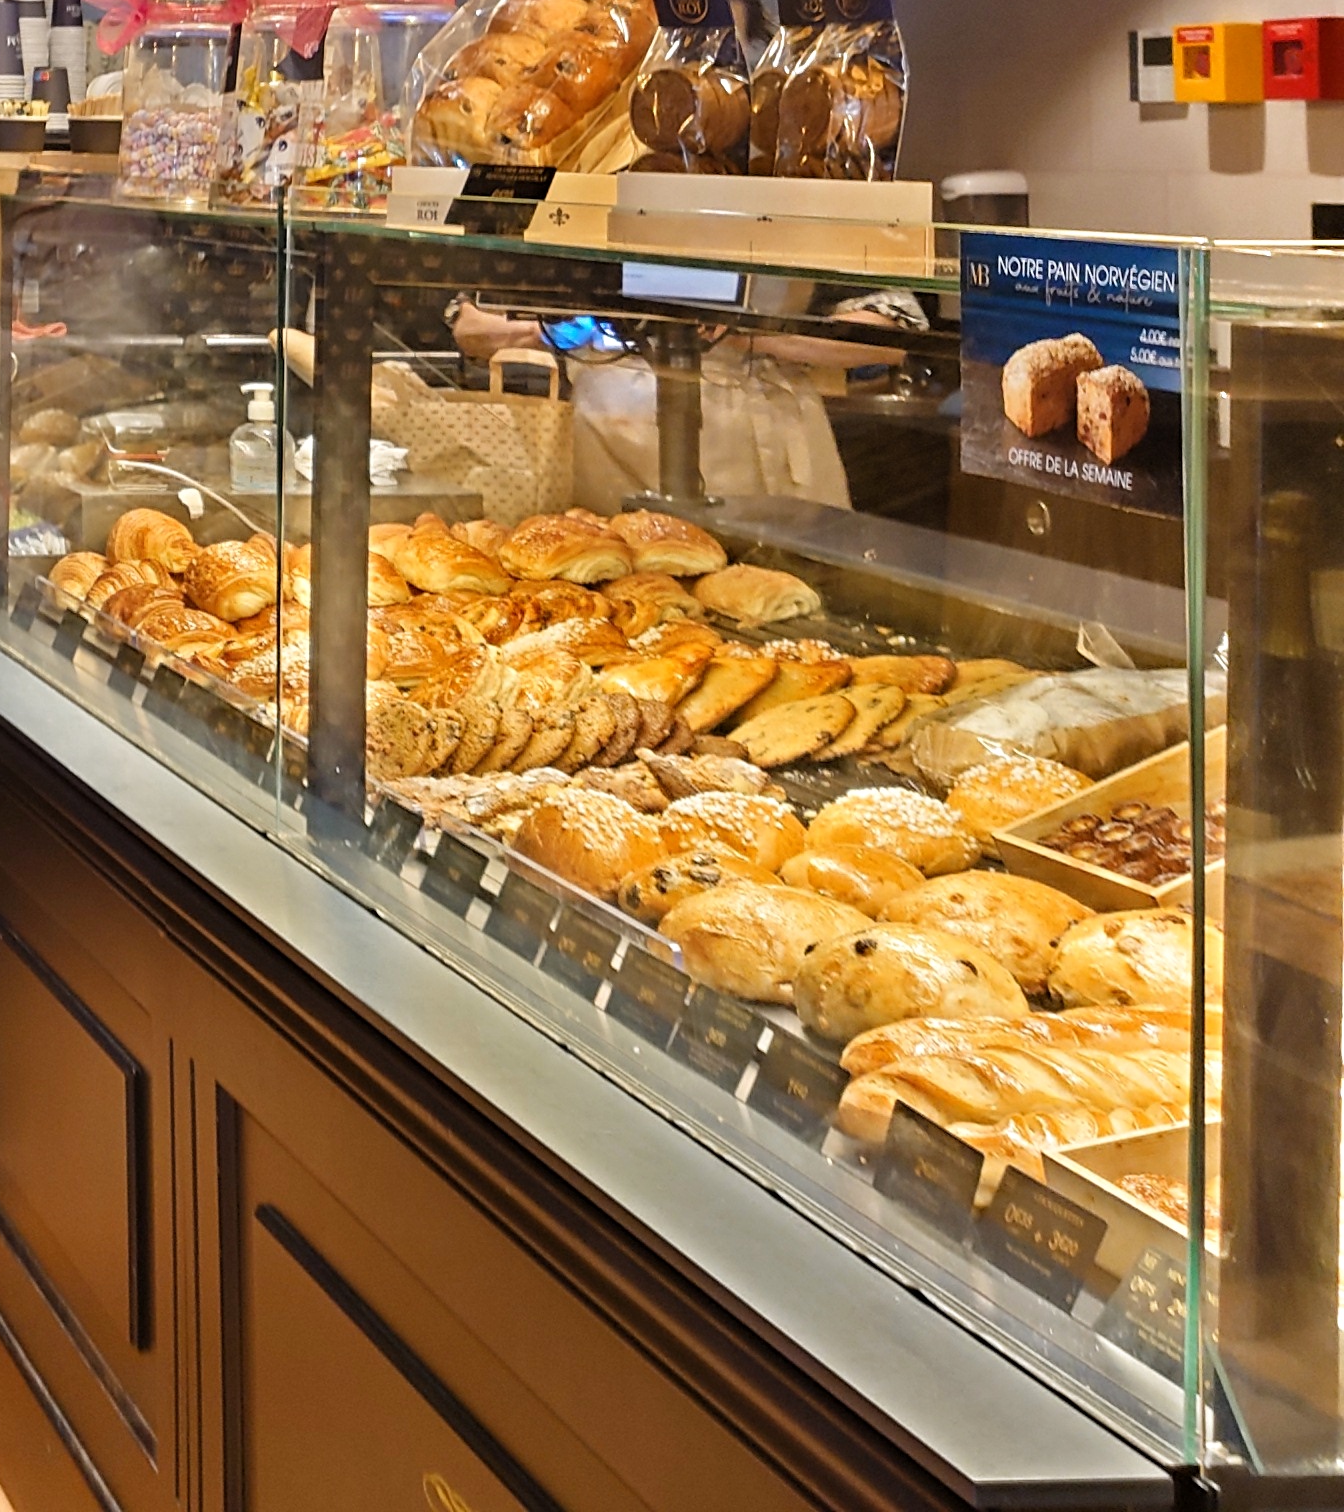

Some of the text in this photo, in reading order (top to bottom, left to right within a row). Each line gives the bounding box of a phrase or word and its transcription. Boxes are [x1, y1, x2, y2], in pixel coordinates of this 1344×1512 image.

[998, 255, 1176, 294] NOTRE PAIN NORVÉGIEN
[1045, 278, 1079, 307] fruits
[1087, 287, 1101, 304] &
[1008, 446, 1133, 492] OFFRE DE LA SEMAINE
